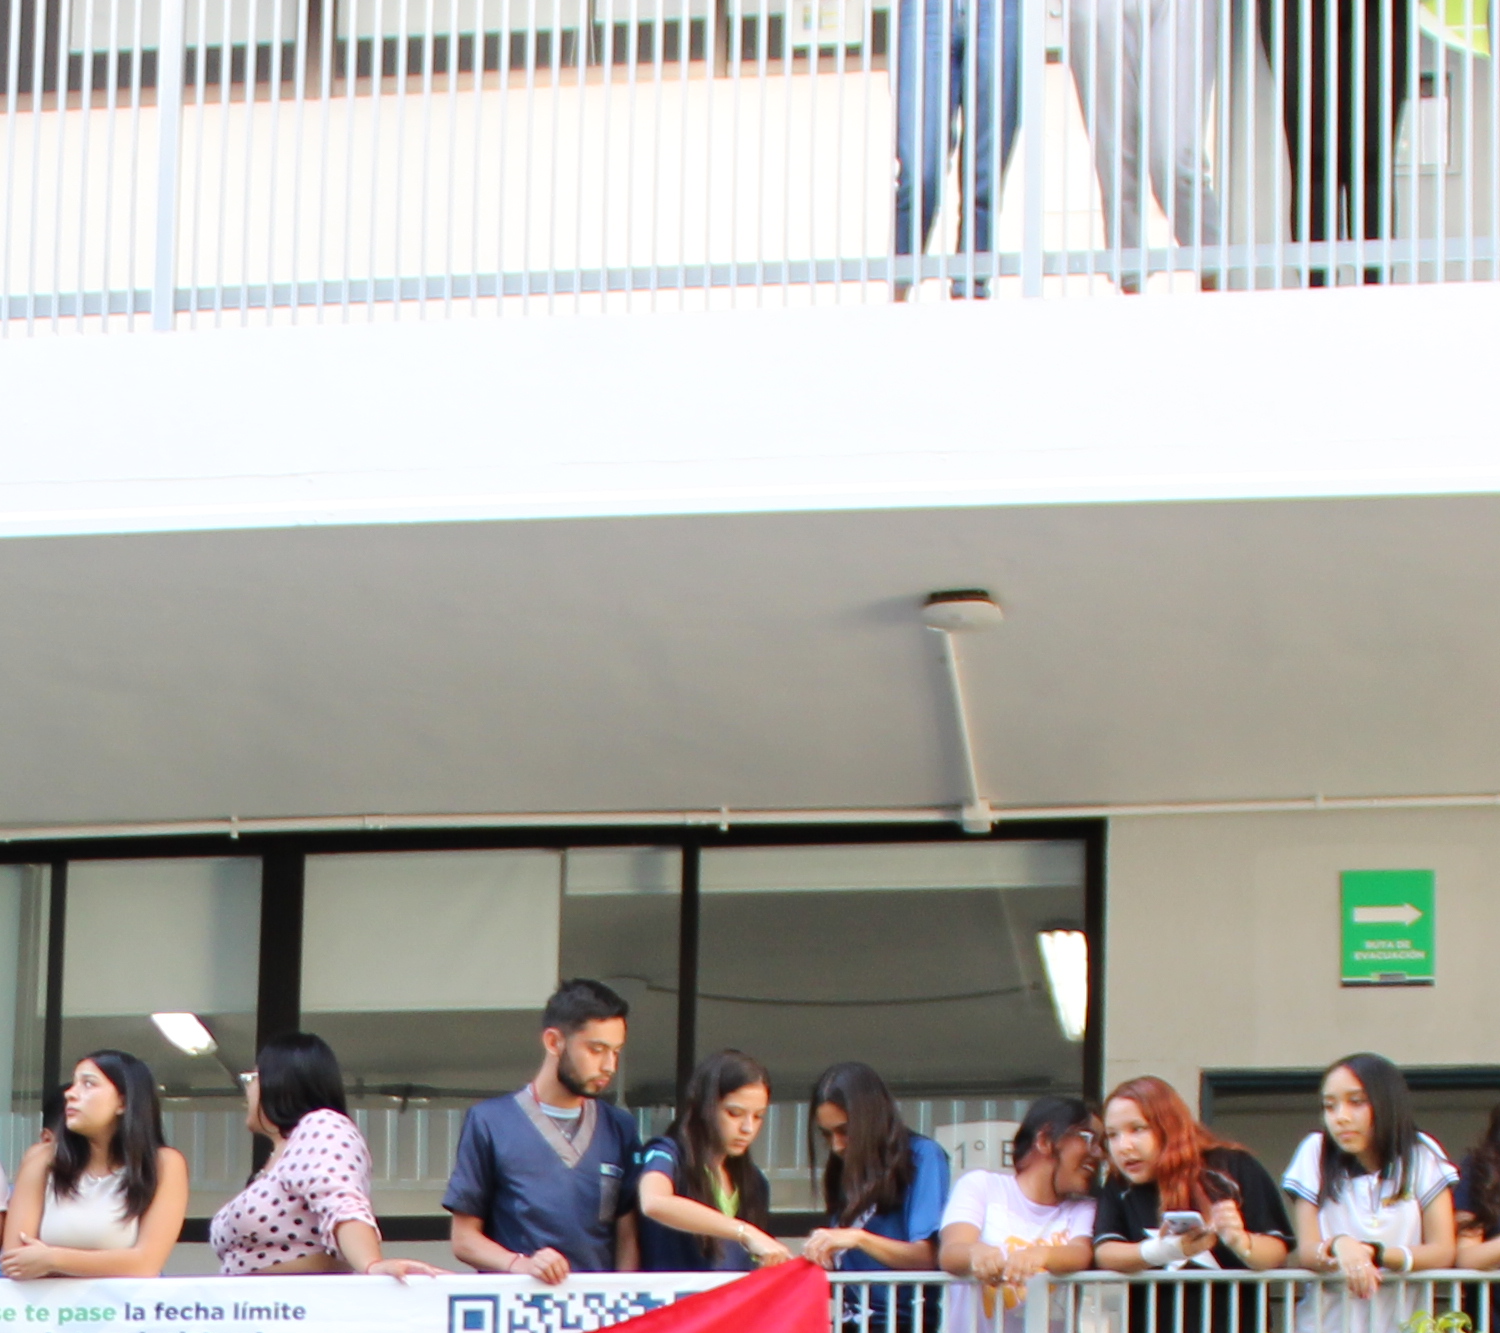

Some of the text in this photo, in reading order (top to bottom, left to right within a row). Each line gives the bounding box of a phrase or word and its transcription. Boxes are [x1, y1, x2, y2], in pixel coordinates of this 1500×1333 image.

[25, 1304, 50, 1322] te
[57, 1306, 116, 1326] pase
[124, 1302, 146, 1321] la
[154, 1302, 225, 1321] fecha
[232, 1302, 307, 1321] límite
